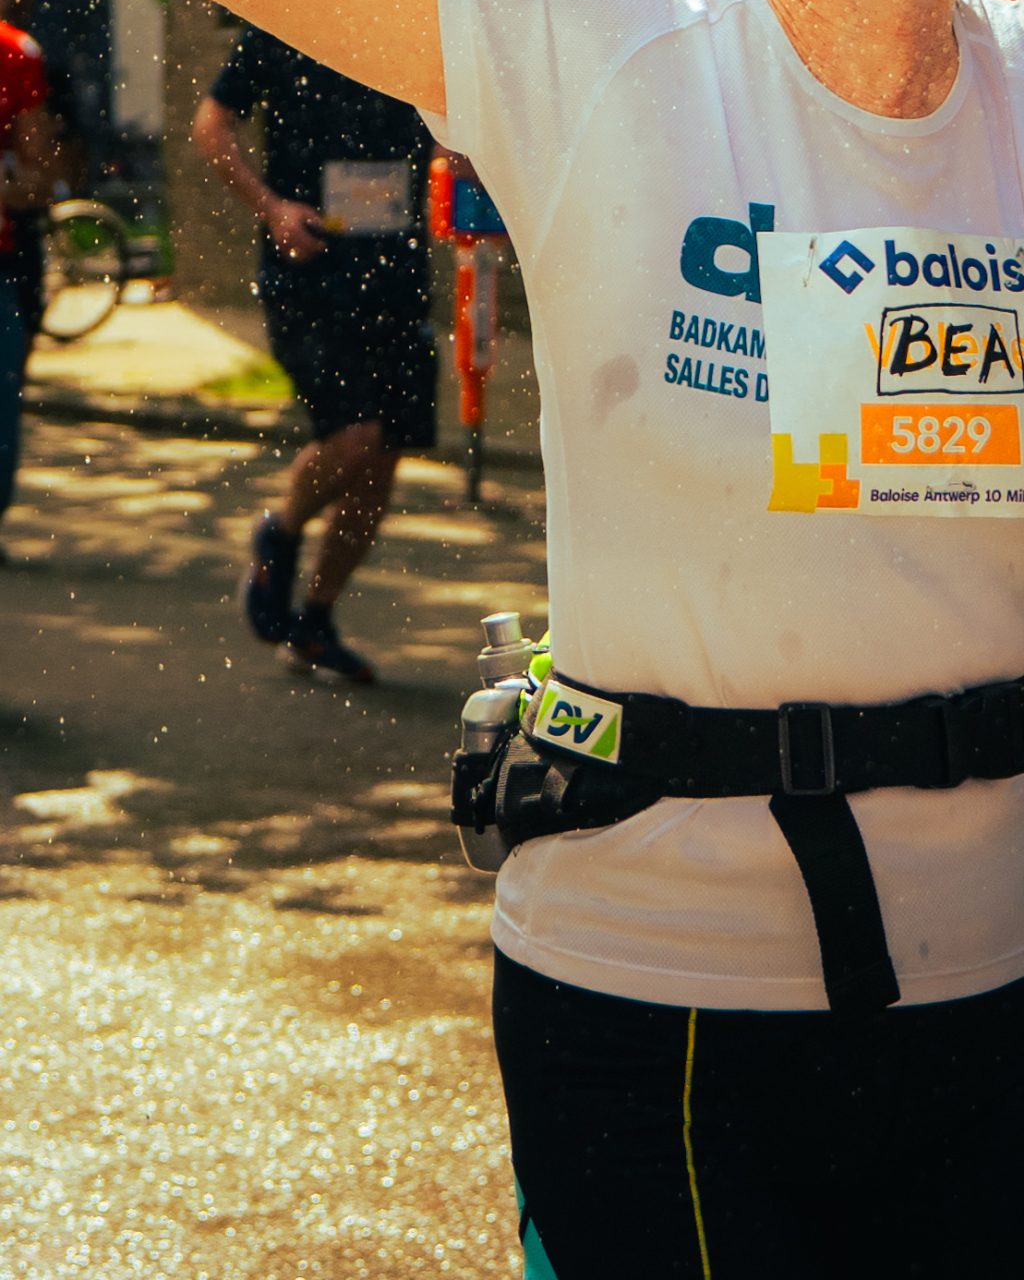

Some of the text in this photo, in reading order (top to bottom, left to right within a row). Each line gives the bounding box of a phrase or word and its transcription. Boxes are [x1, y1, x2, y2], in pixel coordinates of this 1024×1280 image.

[889, 314, 1015, 384] BEA
[664, 353, 749, 399] SALLES
[890, 415, 992, 454] 5829
[870, 488, 920, 503] Baloise
[924, 488, 980, 505] Antwerp
[985, 489, 1001, 502] 10
